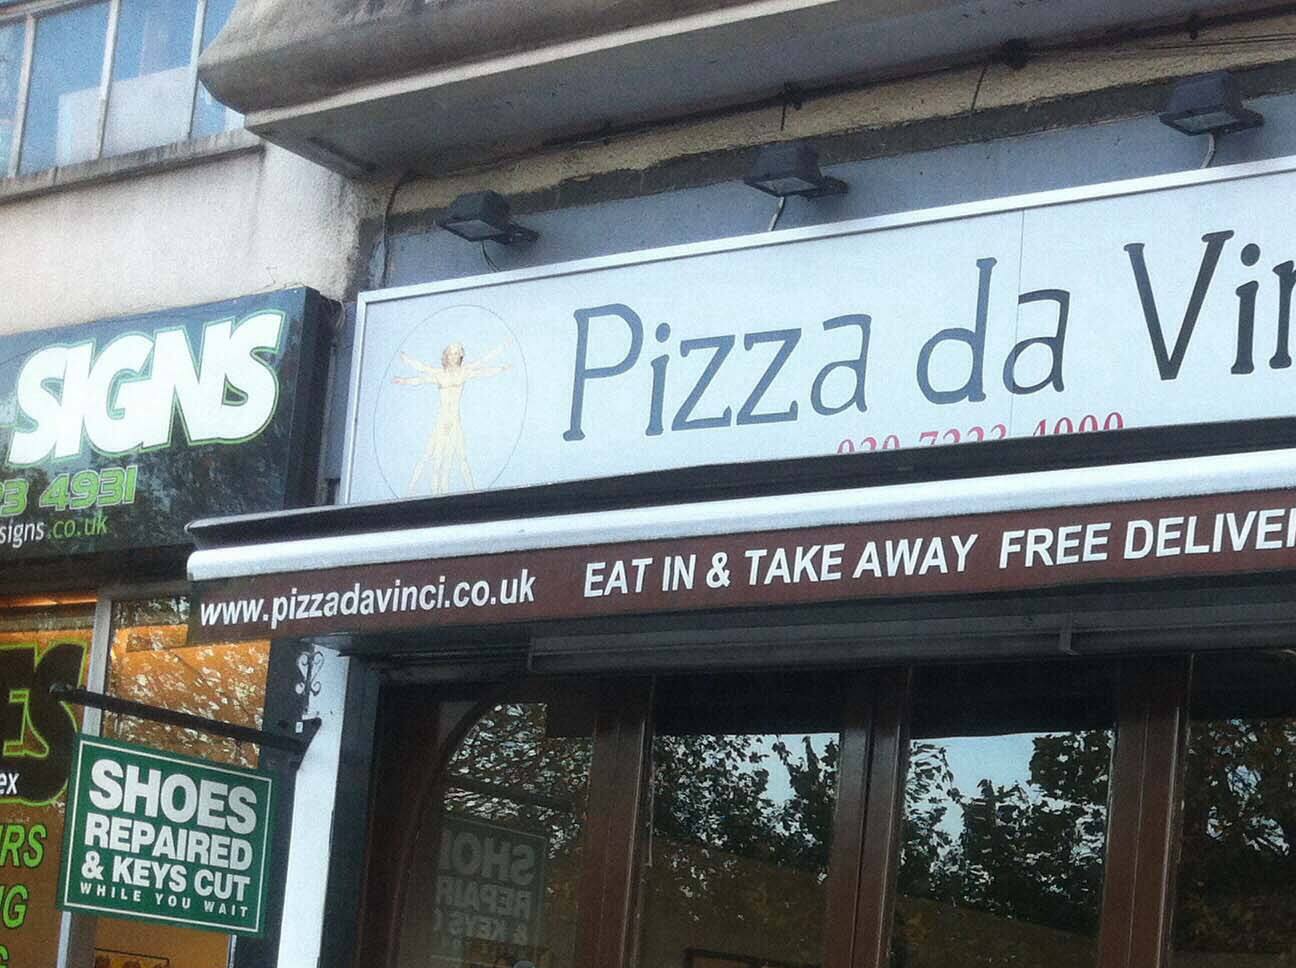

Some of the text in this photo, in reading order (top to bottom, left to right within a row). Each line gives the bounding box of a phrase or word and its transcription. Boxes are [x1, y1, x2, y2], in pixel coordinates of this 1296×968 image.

[561, 302, 872, 441] Pizza
[916, 257, 1071, 405] da
[5, 310, 286, 468] SIGNS
[39, 465, 138, 512] 4931
[583, 557, 653, 598] EAT
[662, 553, 697, 592] IN
[705, 551, 731, 588] &
[743, 543, 846, 586] TAKE
[852, 534, 979, 579] AWAY
[999, 522, 1112, 570] FREE
[200, 569, 535, 629] www.pizzadavinci.co.uk
[89, 759, 258, 834] SHOES
[84, 812, 253, 871] REPAIRED
[80, 881, 249, 917] WHILE YOU WAIT
[81, 851, 251, 901] & KEYS CUT
